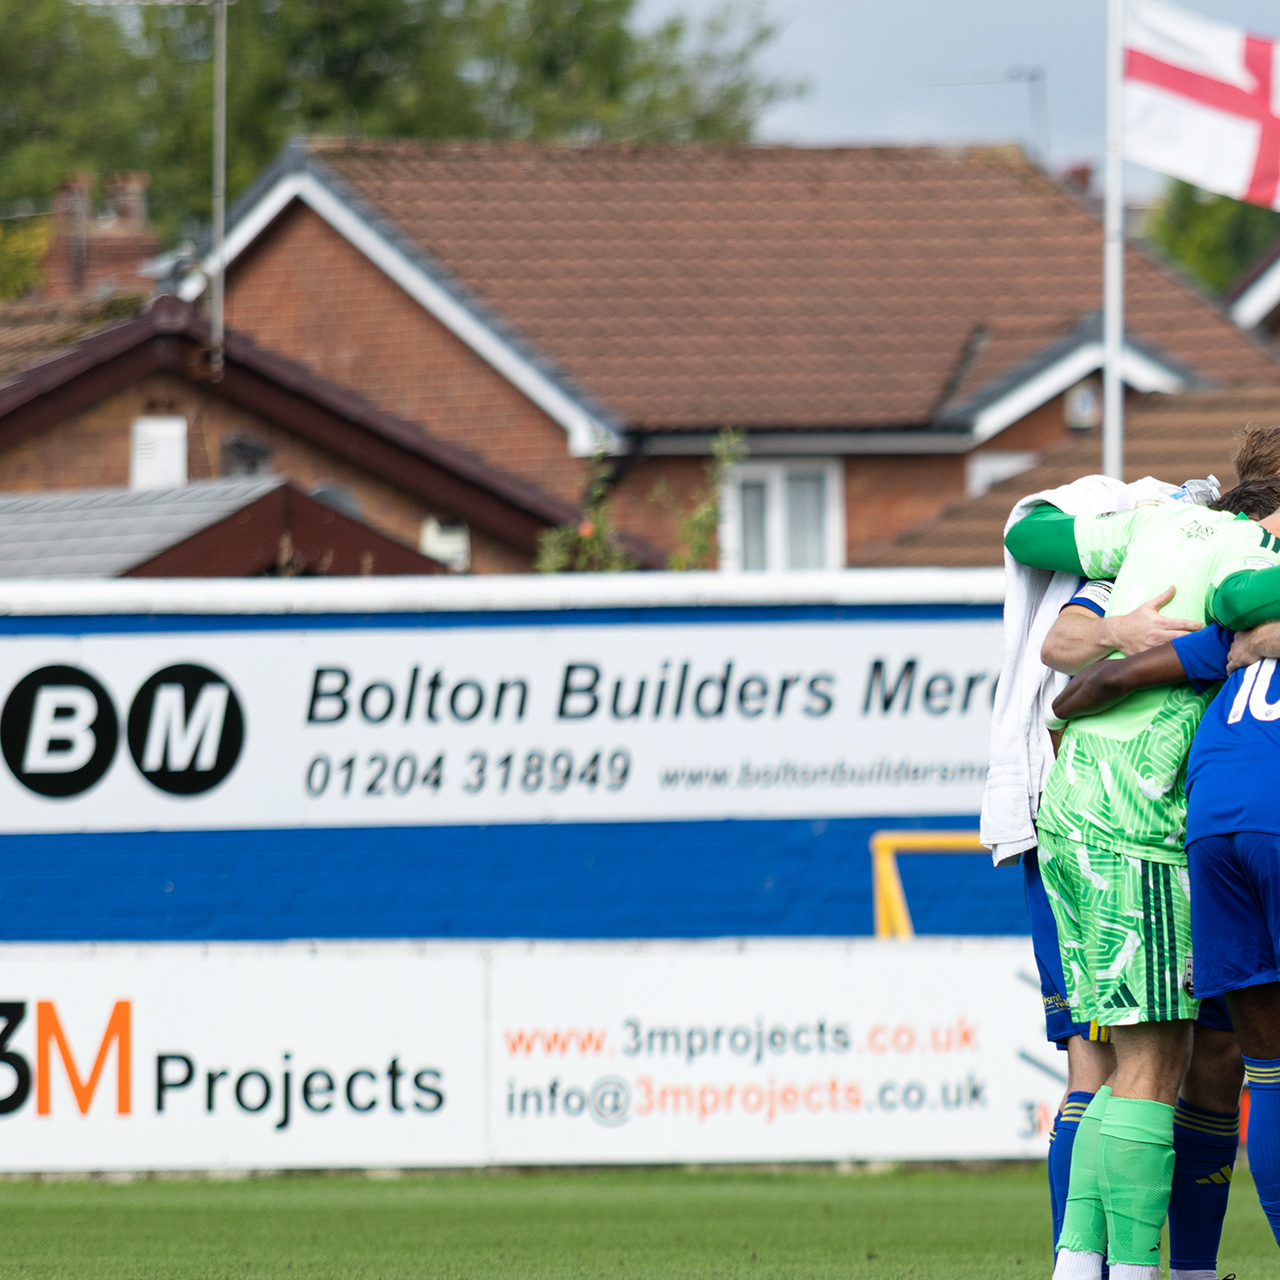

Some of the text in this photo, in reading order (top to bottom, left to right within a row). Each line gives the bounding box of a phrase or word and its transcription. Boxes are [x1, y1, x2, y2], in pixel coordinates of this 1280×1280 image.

[306, 657, 1001, 724] Bolton Builders Mer
[305, 751, 448, 799] 01204
[461, 746, 632, 795] 318949
[504, 1015, 979, 1064] www.3mprojects.co.uk
[155, 1051, 446, 1131] Projects
[506, 1072, 988, 1127] info@3mprojects.co.uk
